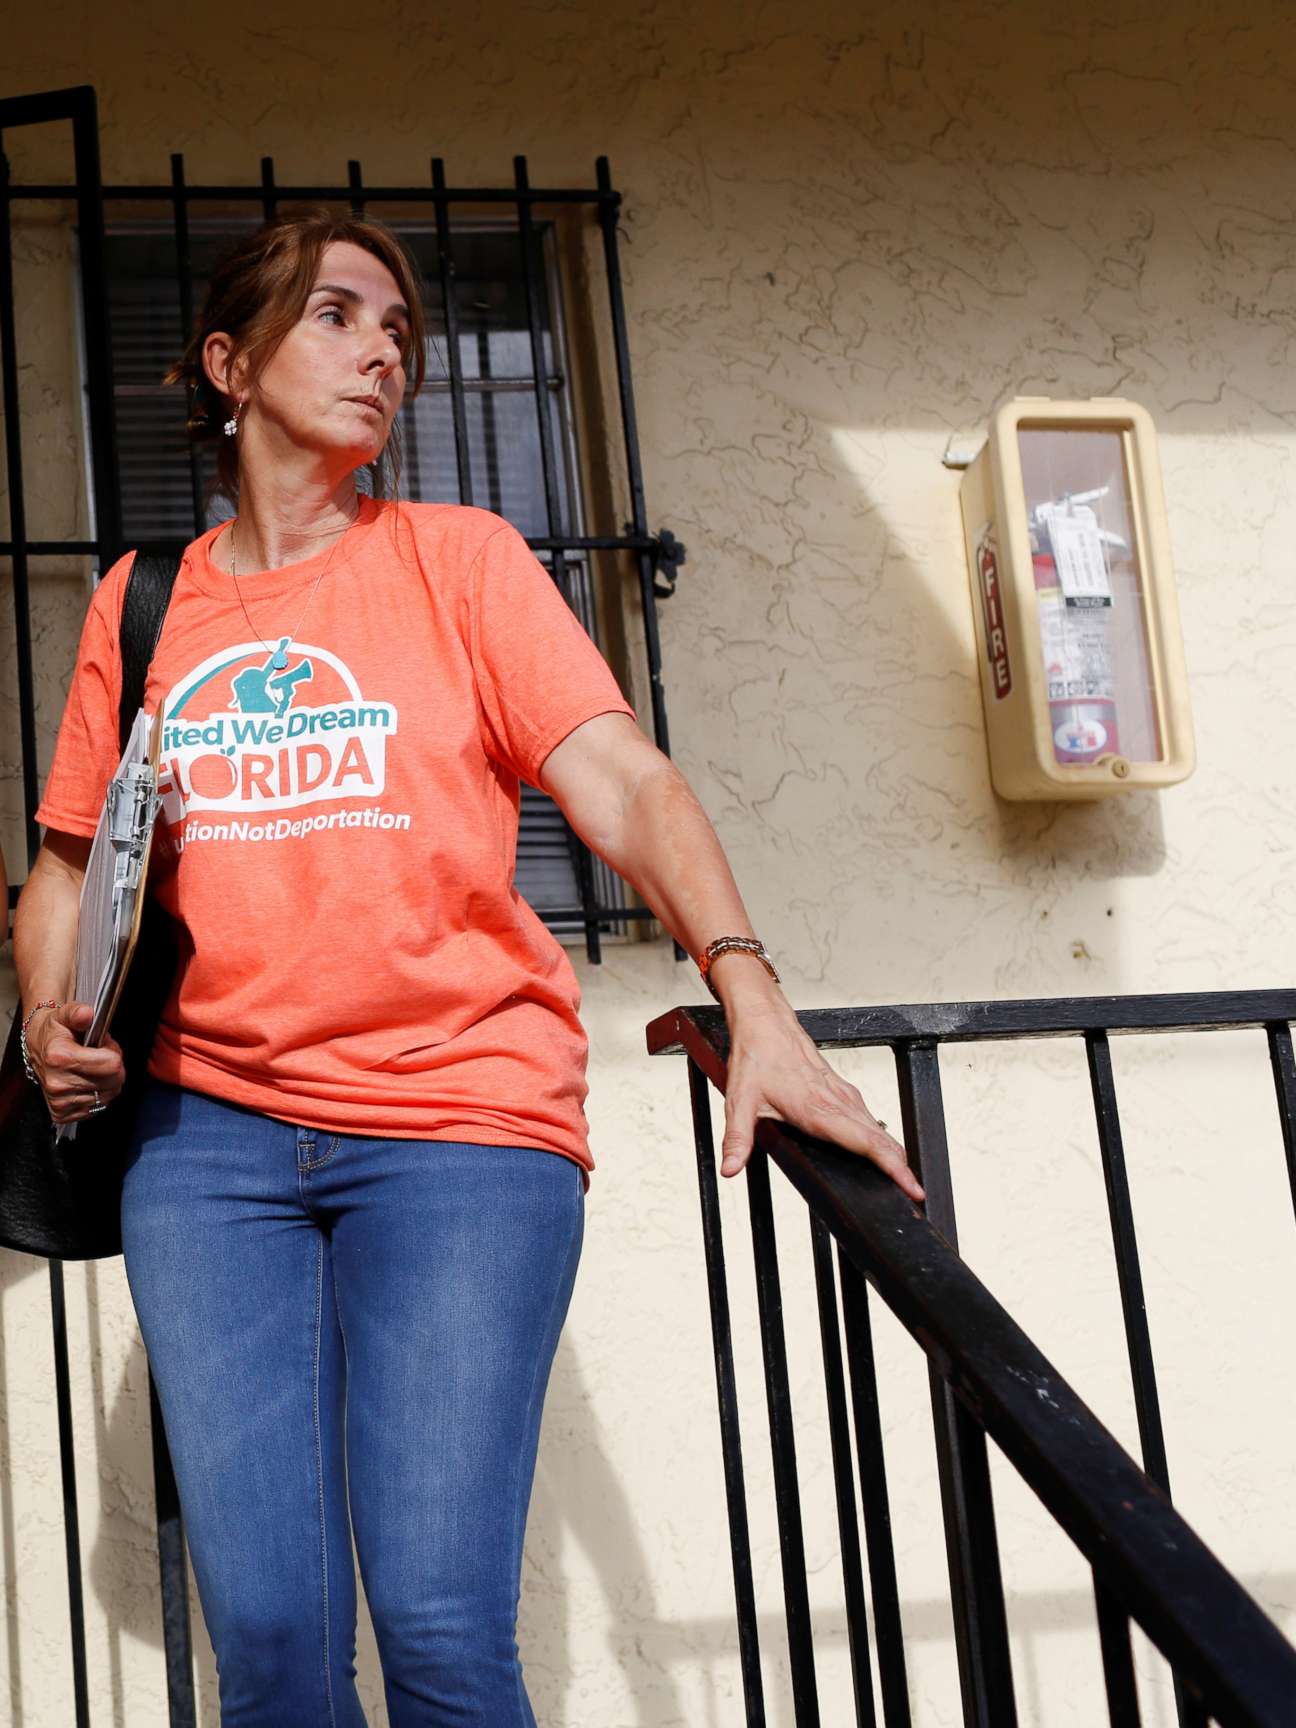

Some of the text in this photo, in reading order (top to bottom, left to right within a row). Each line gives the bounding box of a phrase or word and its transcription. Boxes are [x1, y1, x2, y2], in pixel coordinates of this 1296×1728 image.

[985, 567, 1008, 689] FIRE
[161, 706, 390, 752] ited We Dream
